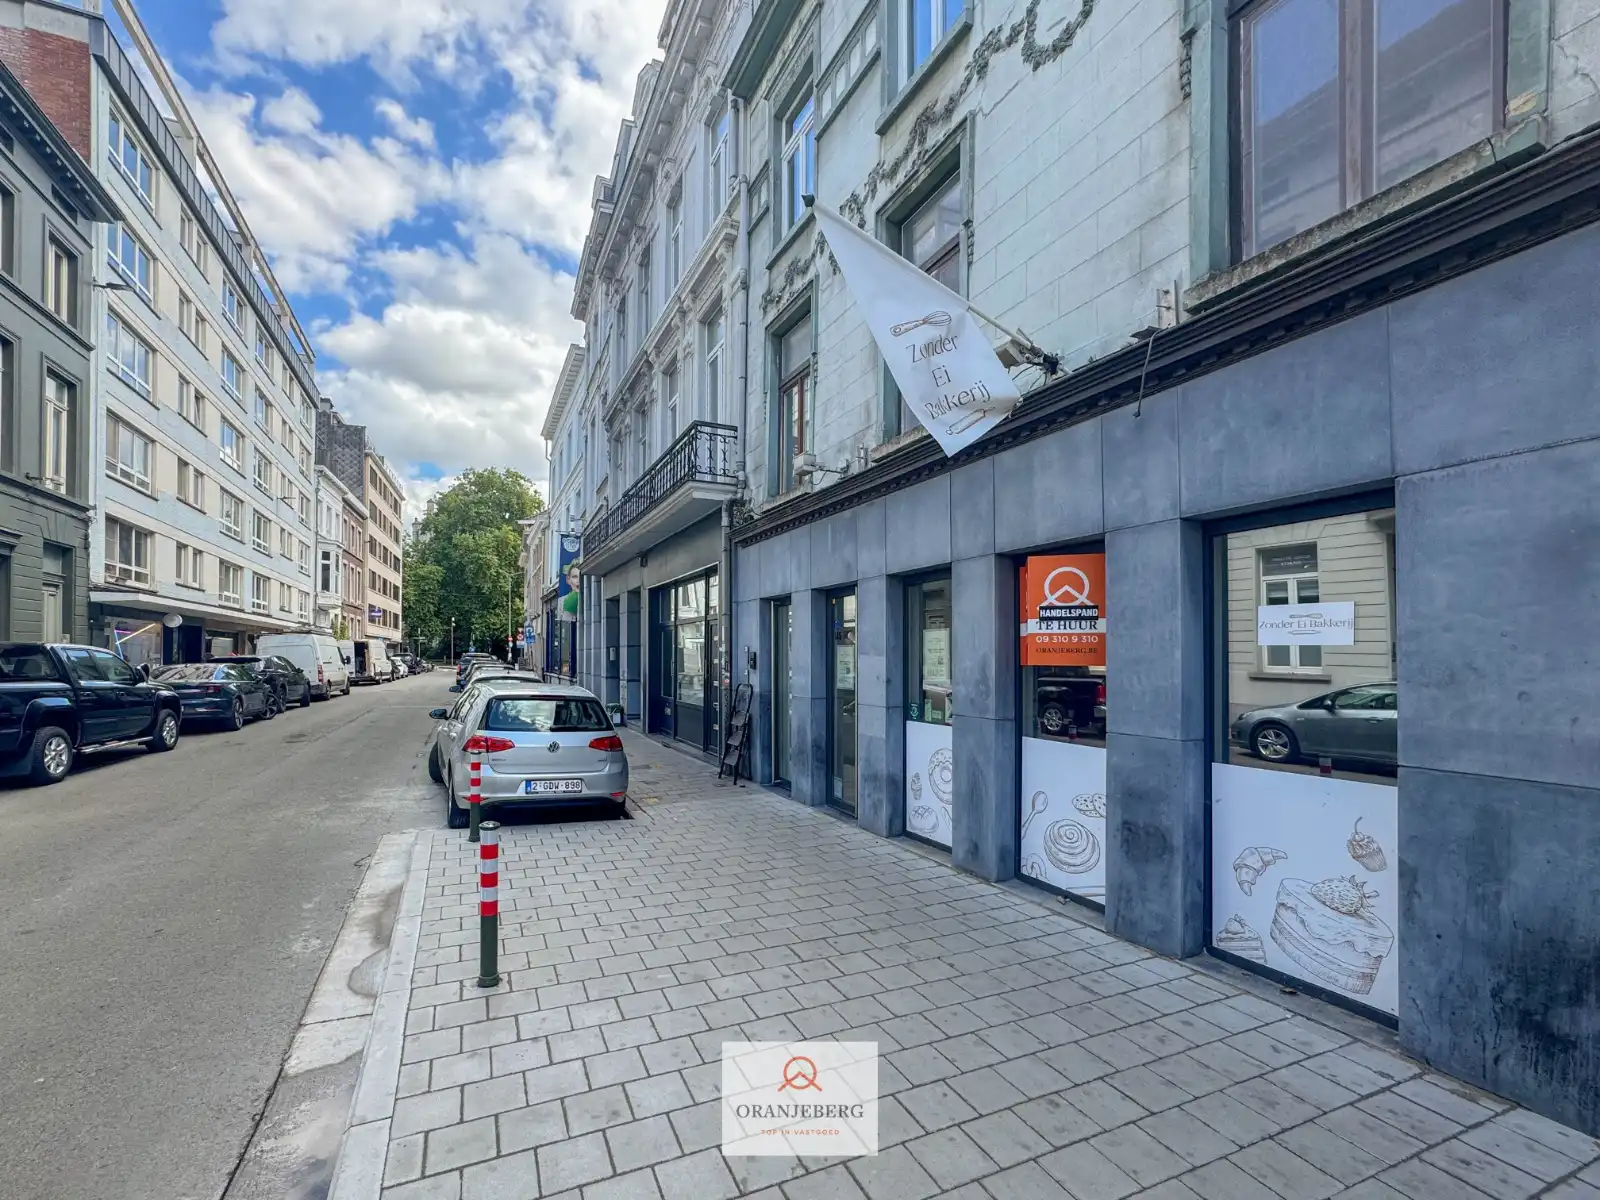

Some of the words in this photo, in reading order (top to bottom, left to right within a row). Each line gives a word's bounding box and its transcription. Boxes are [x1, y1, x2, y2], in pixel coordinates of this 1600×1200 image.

[905, 334, 958, 363] Zonder
[931, 364, 951, 388] Ei
[924, 380, 991, 420] Bakkerij
[1040, 608, 1098, 617] HANDELSPAND
[1036, 620, 1054, 631] TE
[1057, 620, 1098, 631] HUUR
[1259, 620, 1294, 629] Zonder
[1297, 619, 1307, 629] Ei
[1309, 618, 1353, 629] Bakkerij
[1036, 635, 1049, 643] 09
[1051, 635, 1069, 643] 310
[1071, 635, 1079, 643] 9
[1081, 635, 1098, 643] 310
